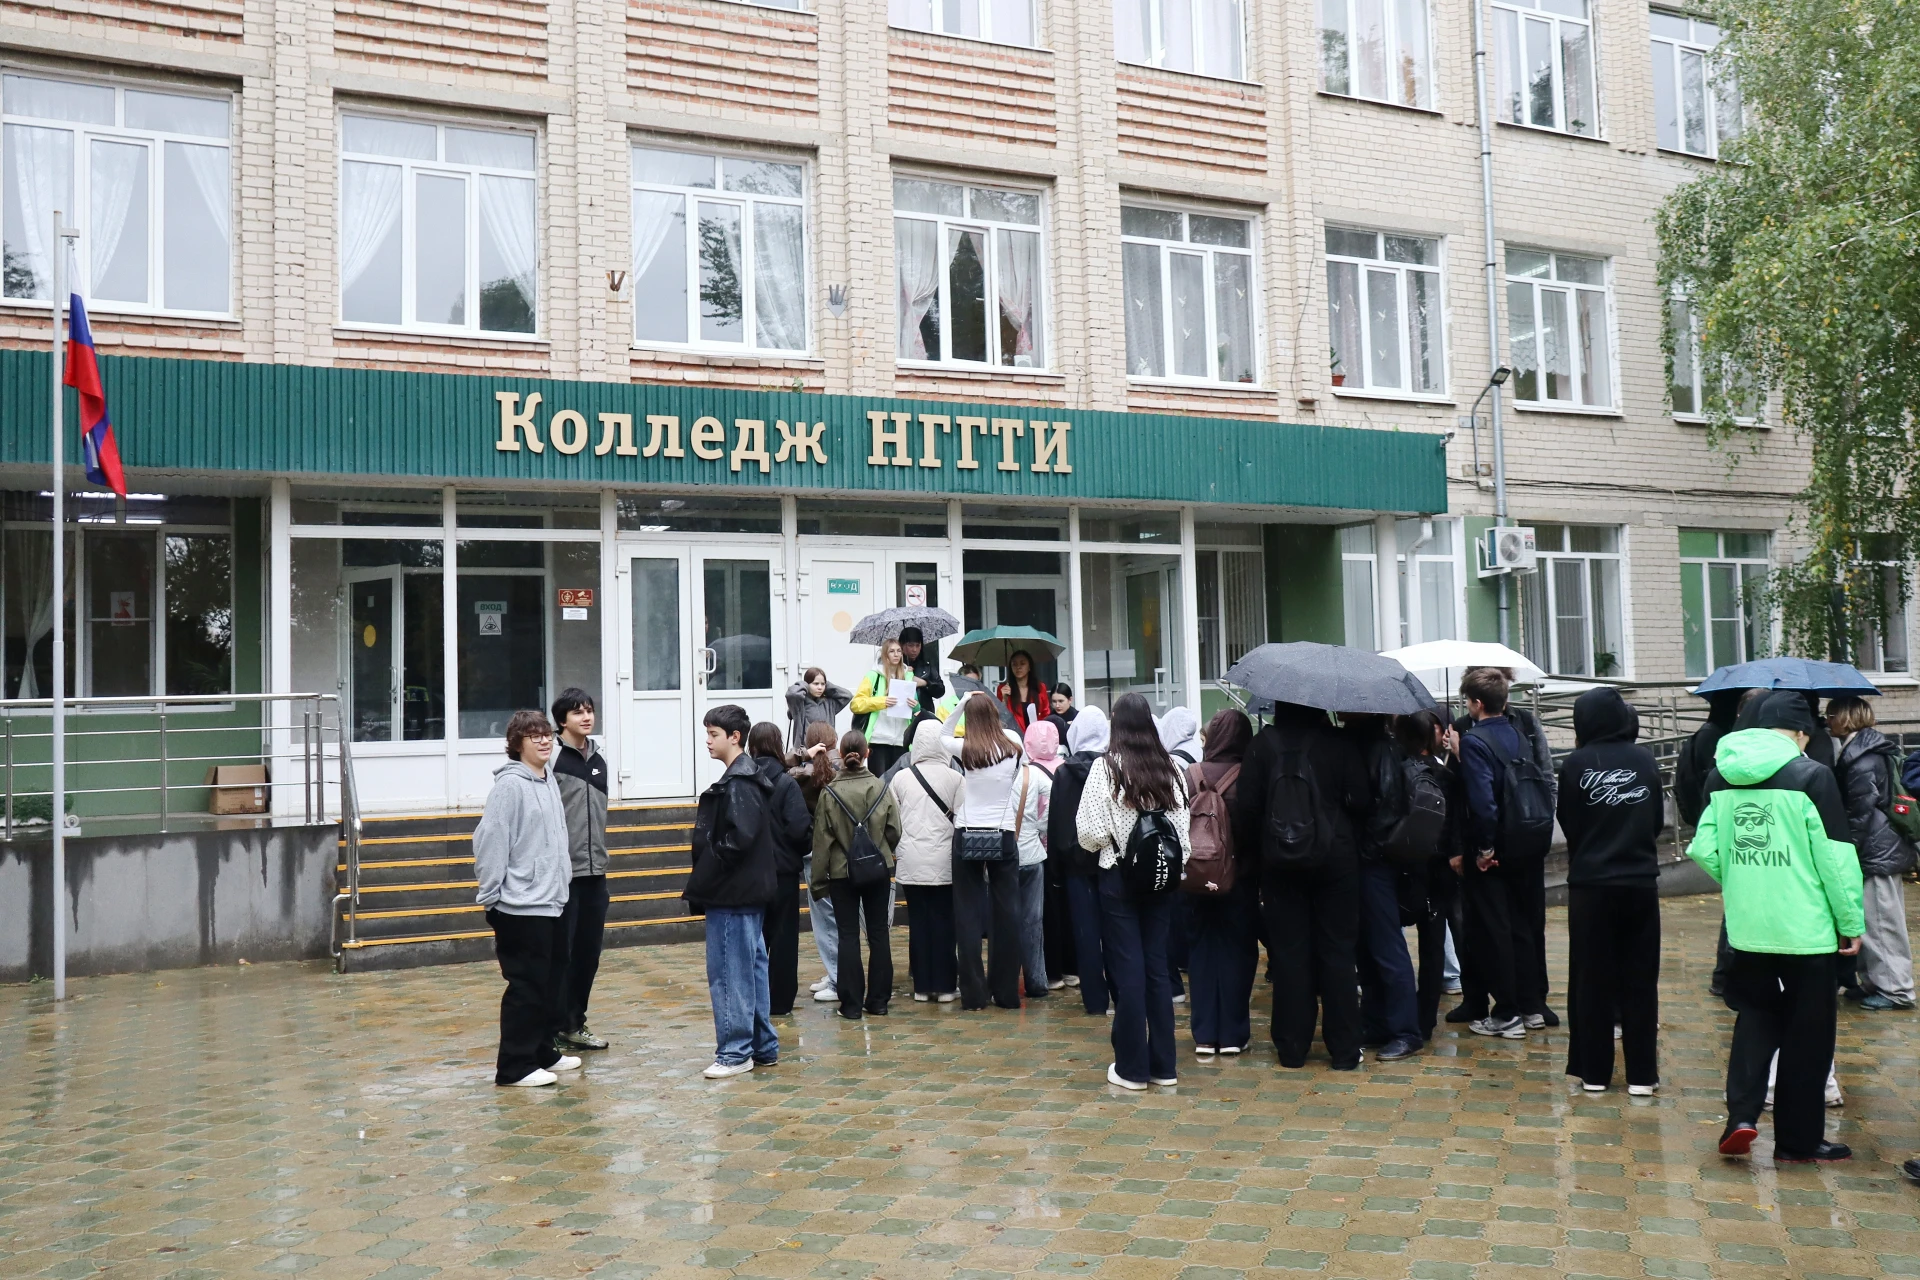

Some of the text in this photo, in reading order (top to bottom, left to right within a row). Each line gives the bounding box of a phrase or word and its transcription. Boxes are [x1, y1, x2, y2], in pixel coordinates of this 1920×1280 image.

[496, 391, 1072, 474] Колледж НГГТИ
[480, 603, 502, 611] ВХОД
[1580, 768, 1637, 789] Without
[1728, 844, 1791, 867] INKVIN
